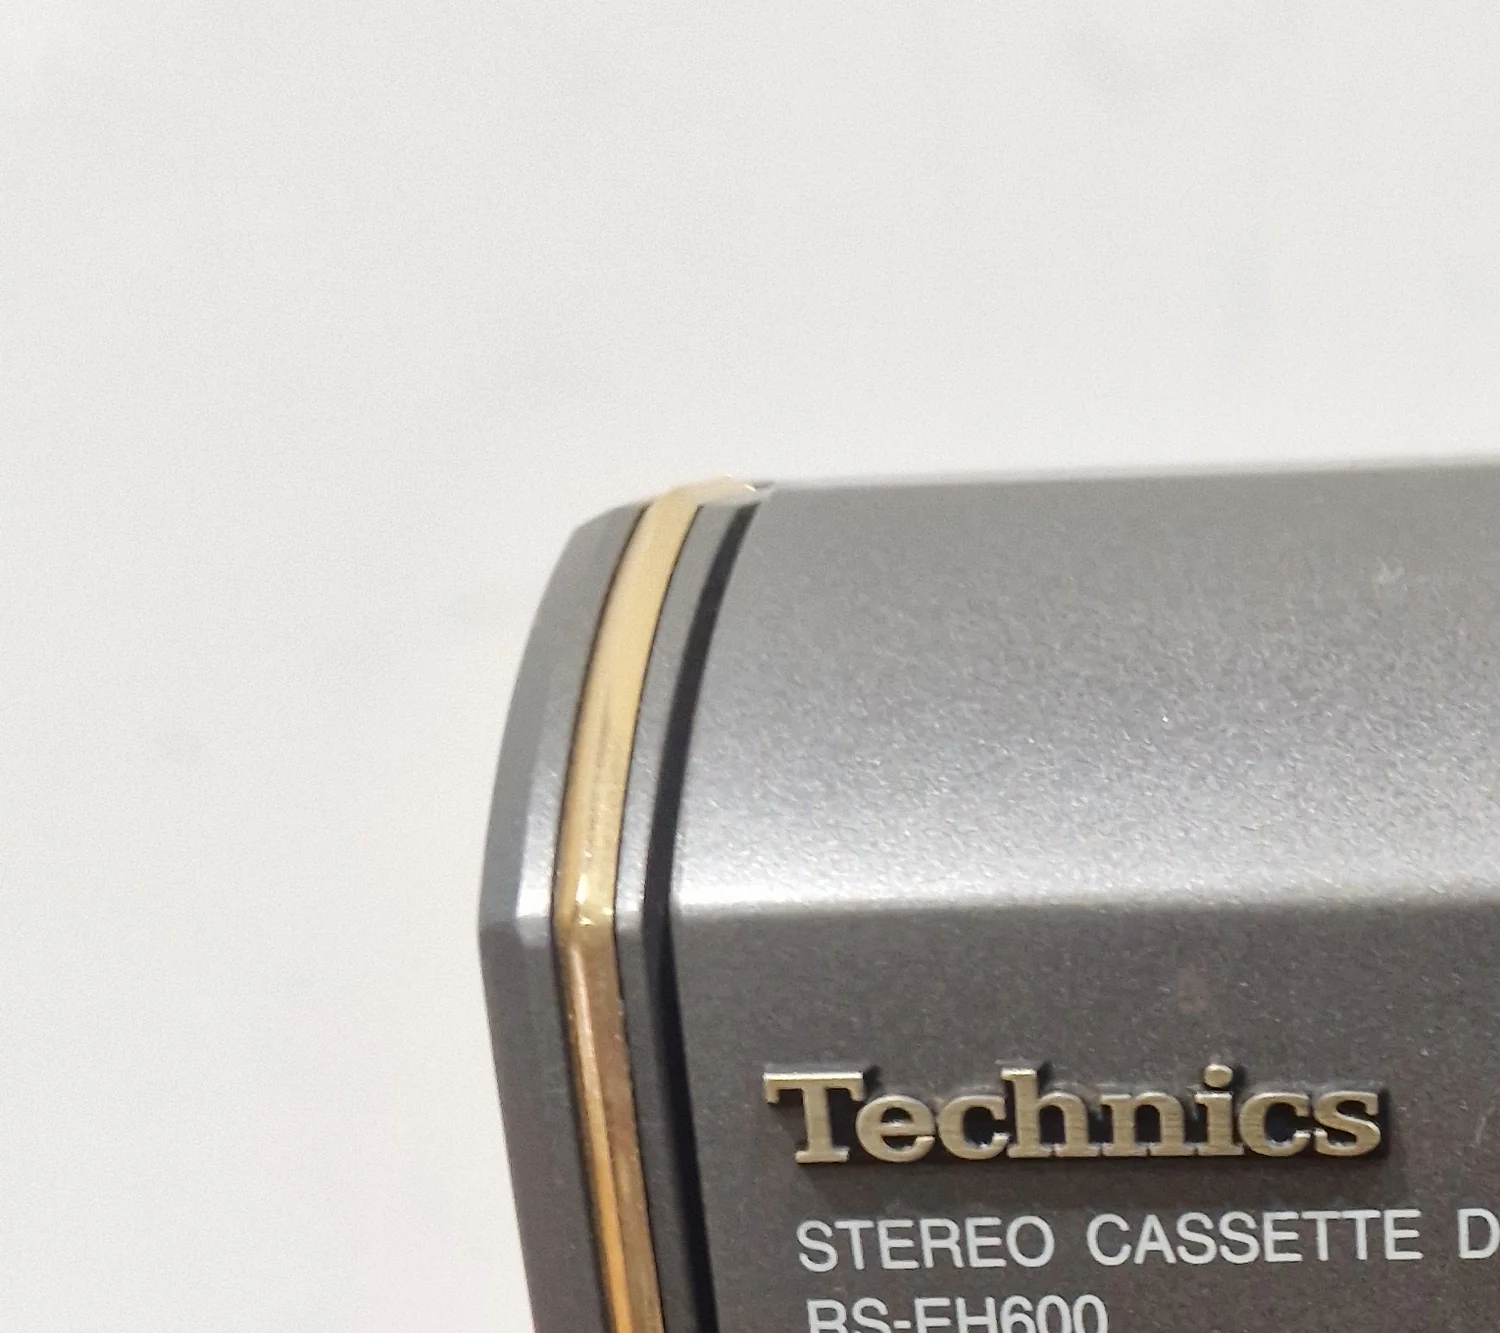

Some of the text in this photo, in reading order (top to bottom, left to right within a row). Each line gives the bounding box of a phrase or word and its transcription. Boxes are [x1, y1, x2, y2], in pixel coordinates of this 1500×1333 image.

[763, 1062, 1386, 1164] Technics
[797, 1214, 1053, 1272] STEREO
[1087, 1208, 1421, 1266] CASSETTE
